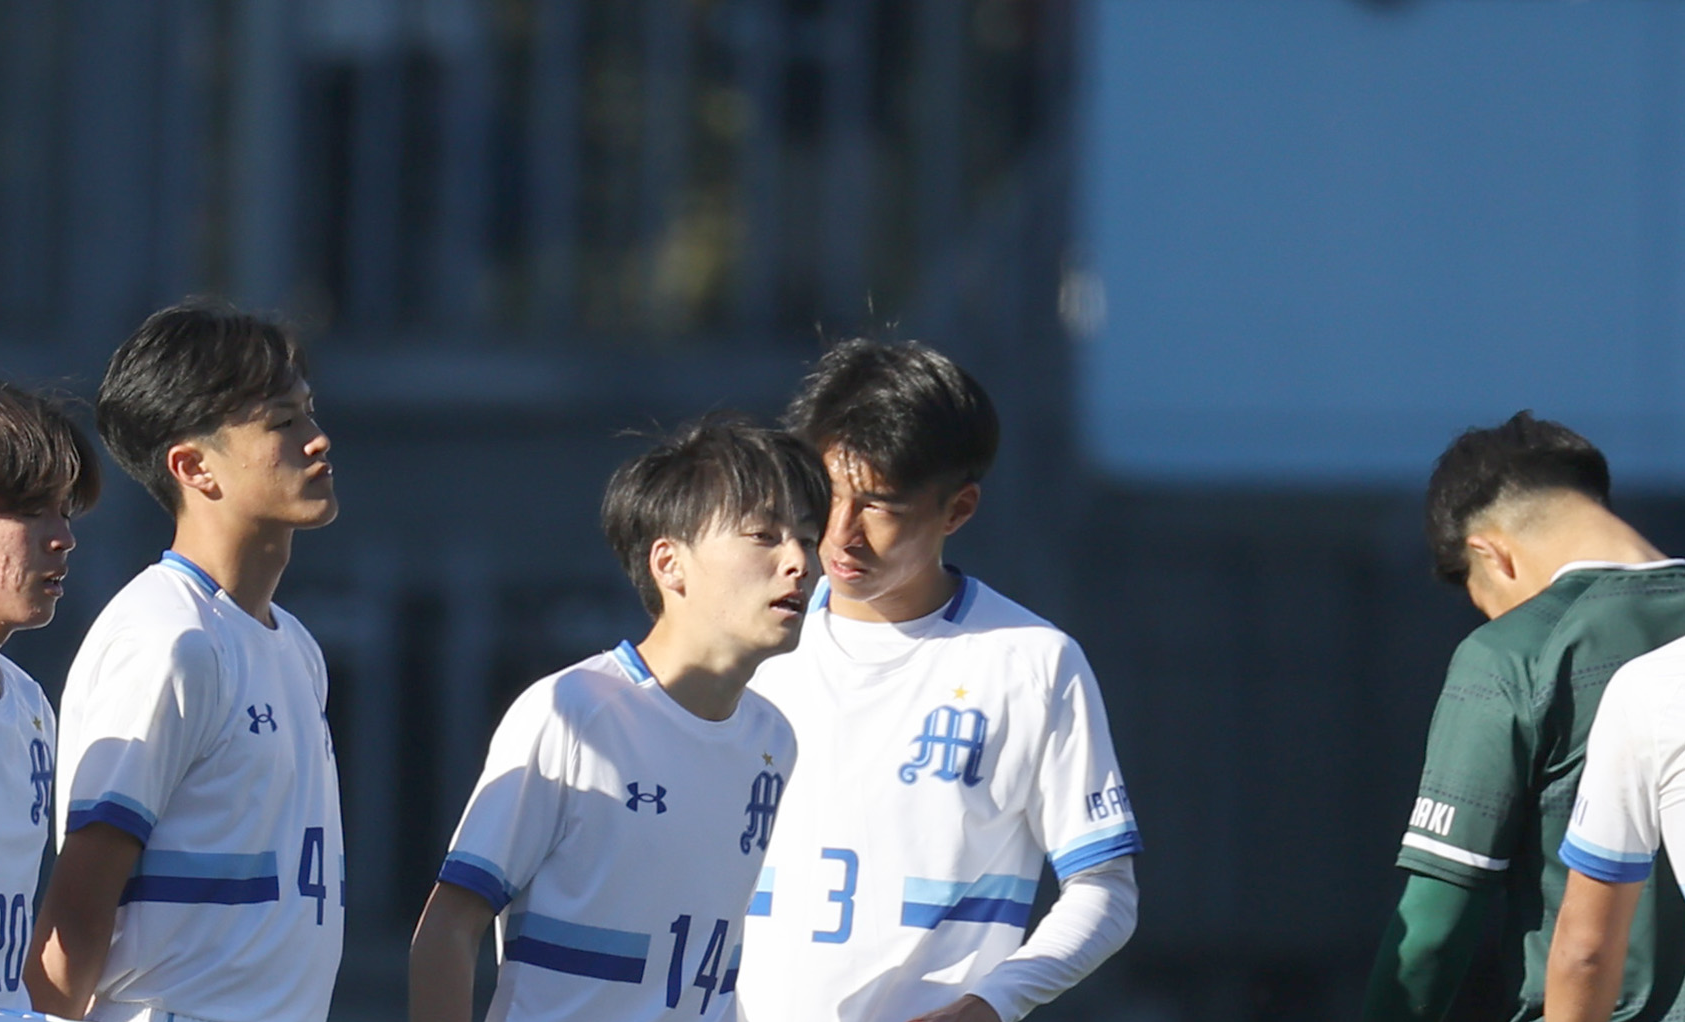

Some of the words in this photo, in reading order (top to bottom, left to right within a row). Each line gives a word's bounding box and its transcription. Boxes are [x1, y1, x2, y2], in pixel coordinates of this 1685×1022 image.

[298, 827, 326, 925] 4
[812, 847, 859, 944] 3
[666, 914, 729, 1015] 14
